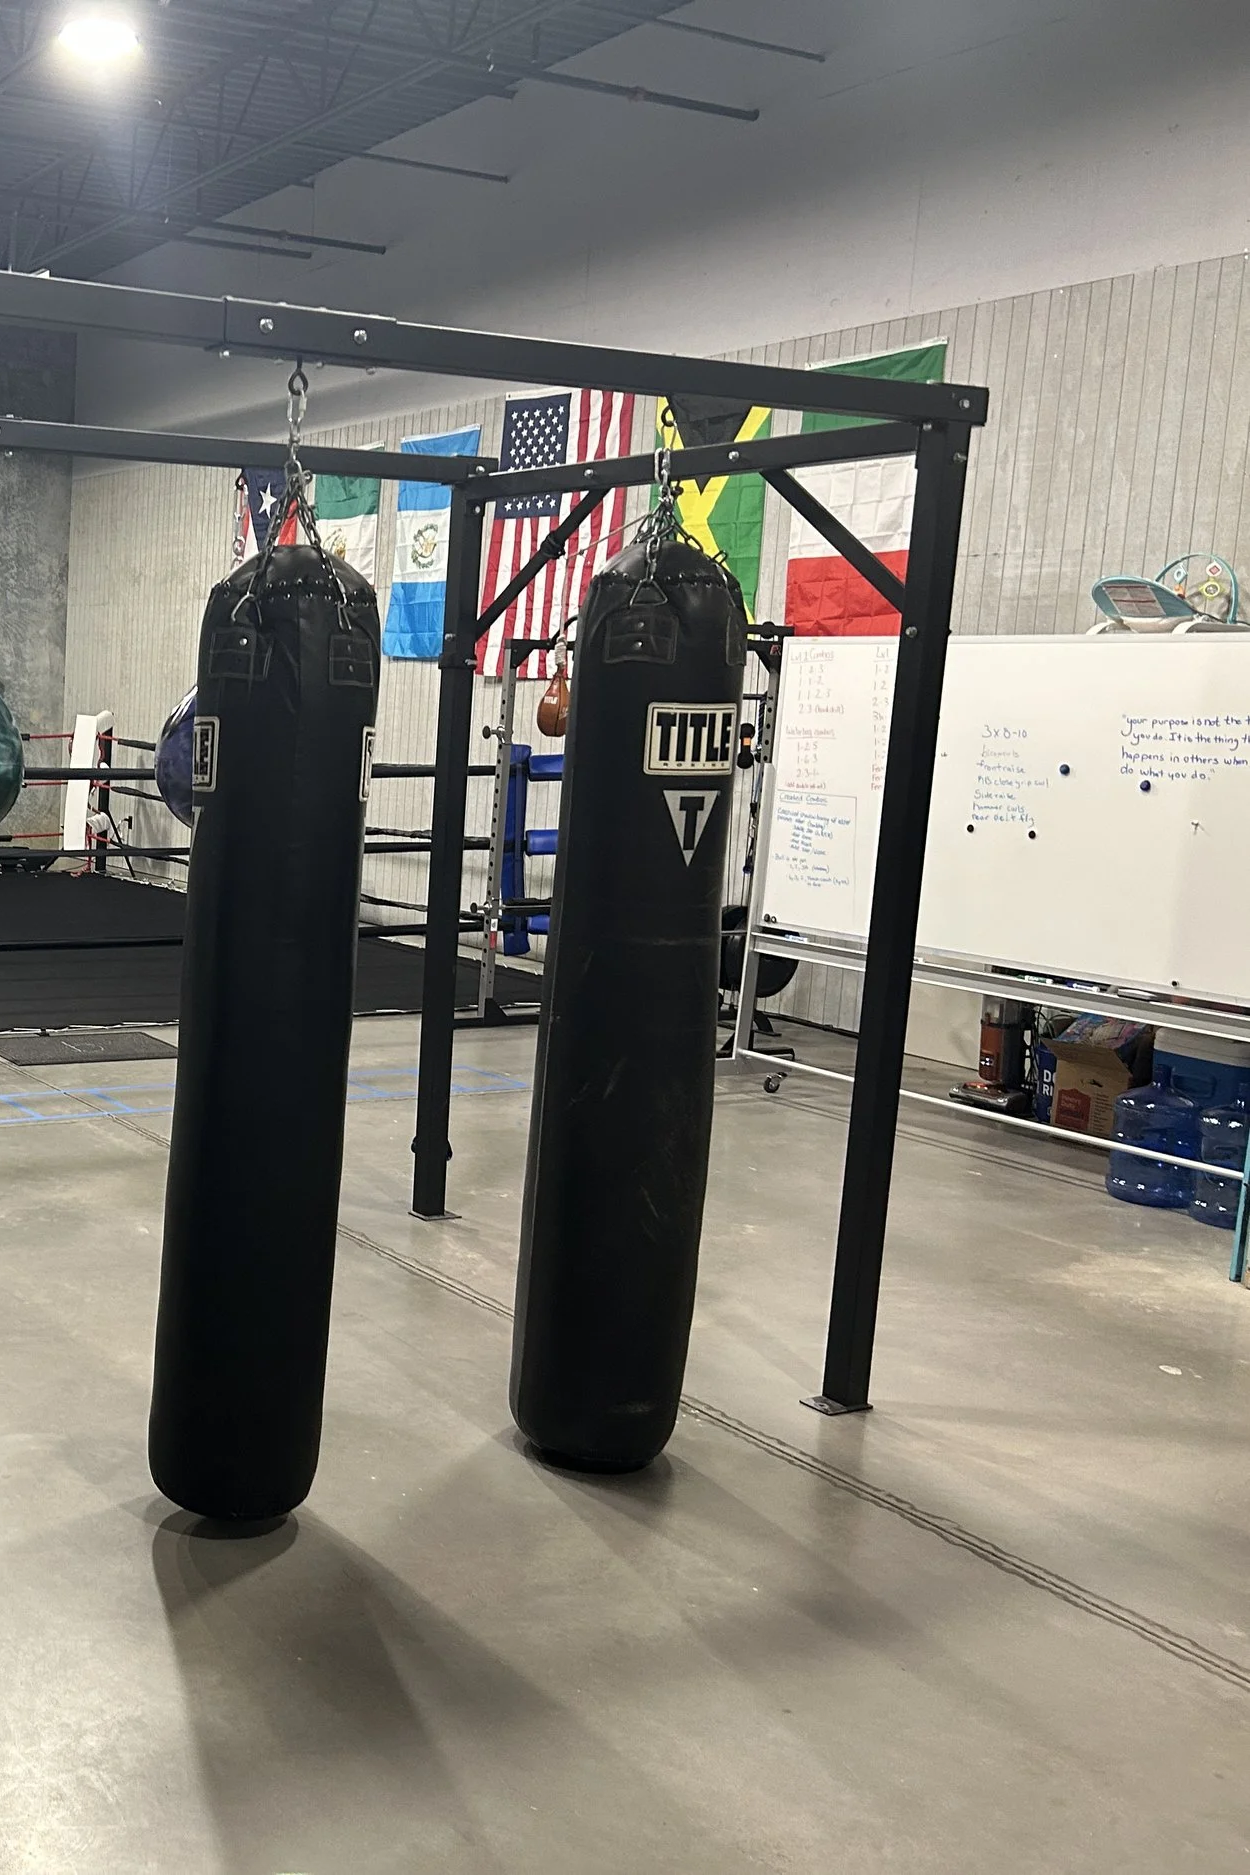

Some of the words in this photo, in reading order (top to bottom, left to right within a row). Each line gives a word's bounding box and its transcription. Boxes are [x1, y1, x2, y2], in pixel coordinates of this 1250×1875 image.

[1204, 716, 1220, 727] not
[1224, 715, 1242, 725] the
[656, 711, 732, 762] TITLE
[1130, 732, 1151, 746] you
[1195, 732, 1211, 743] the
[1214, 734, 1239, 752] thing
[1170, 753, 1180, 763] in
[1183, 754, 1219, 765] others
[1223, 755, 1248, 766] when
[1120, 763, 1134, 775] do
[1140, 766, 1164, 778] what
[1168, 772, 1187, 780] you
[679, 796, 705, 850] T
